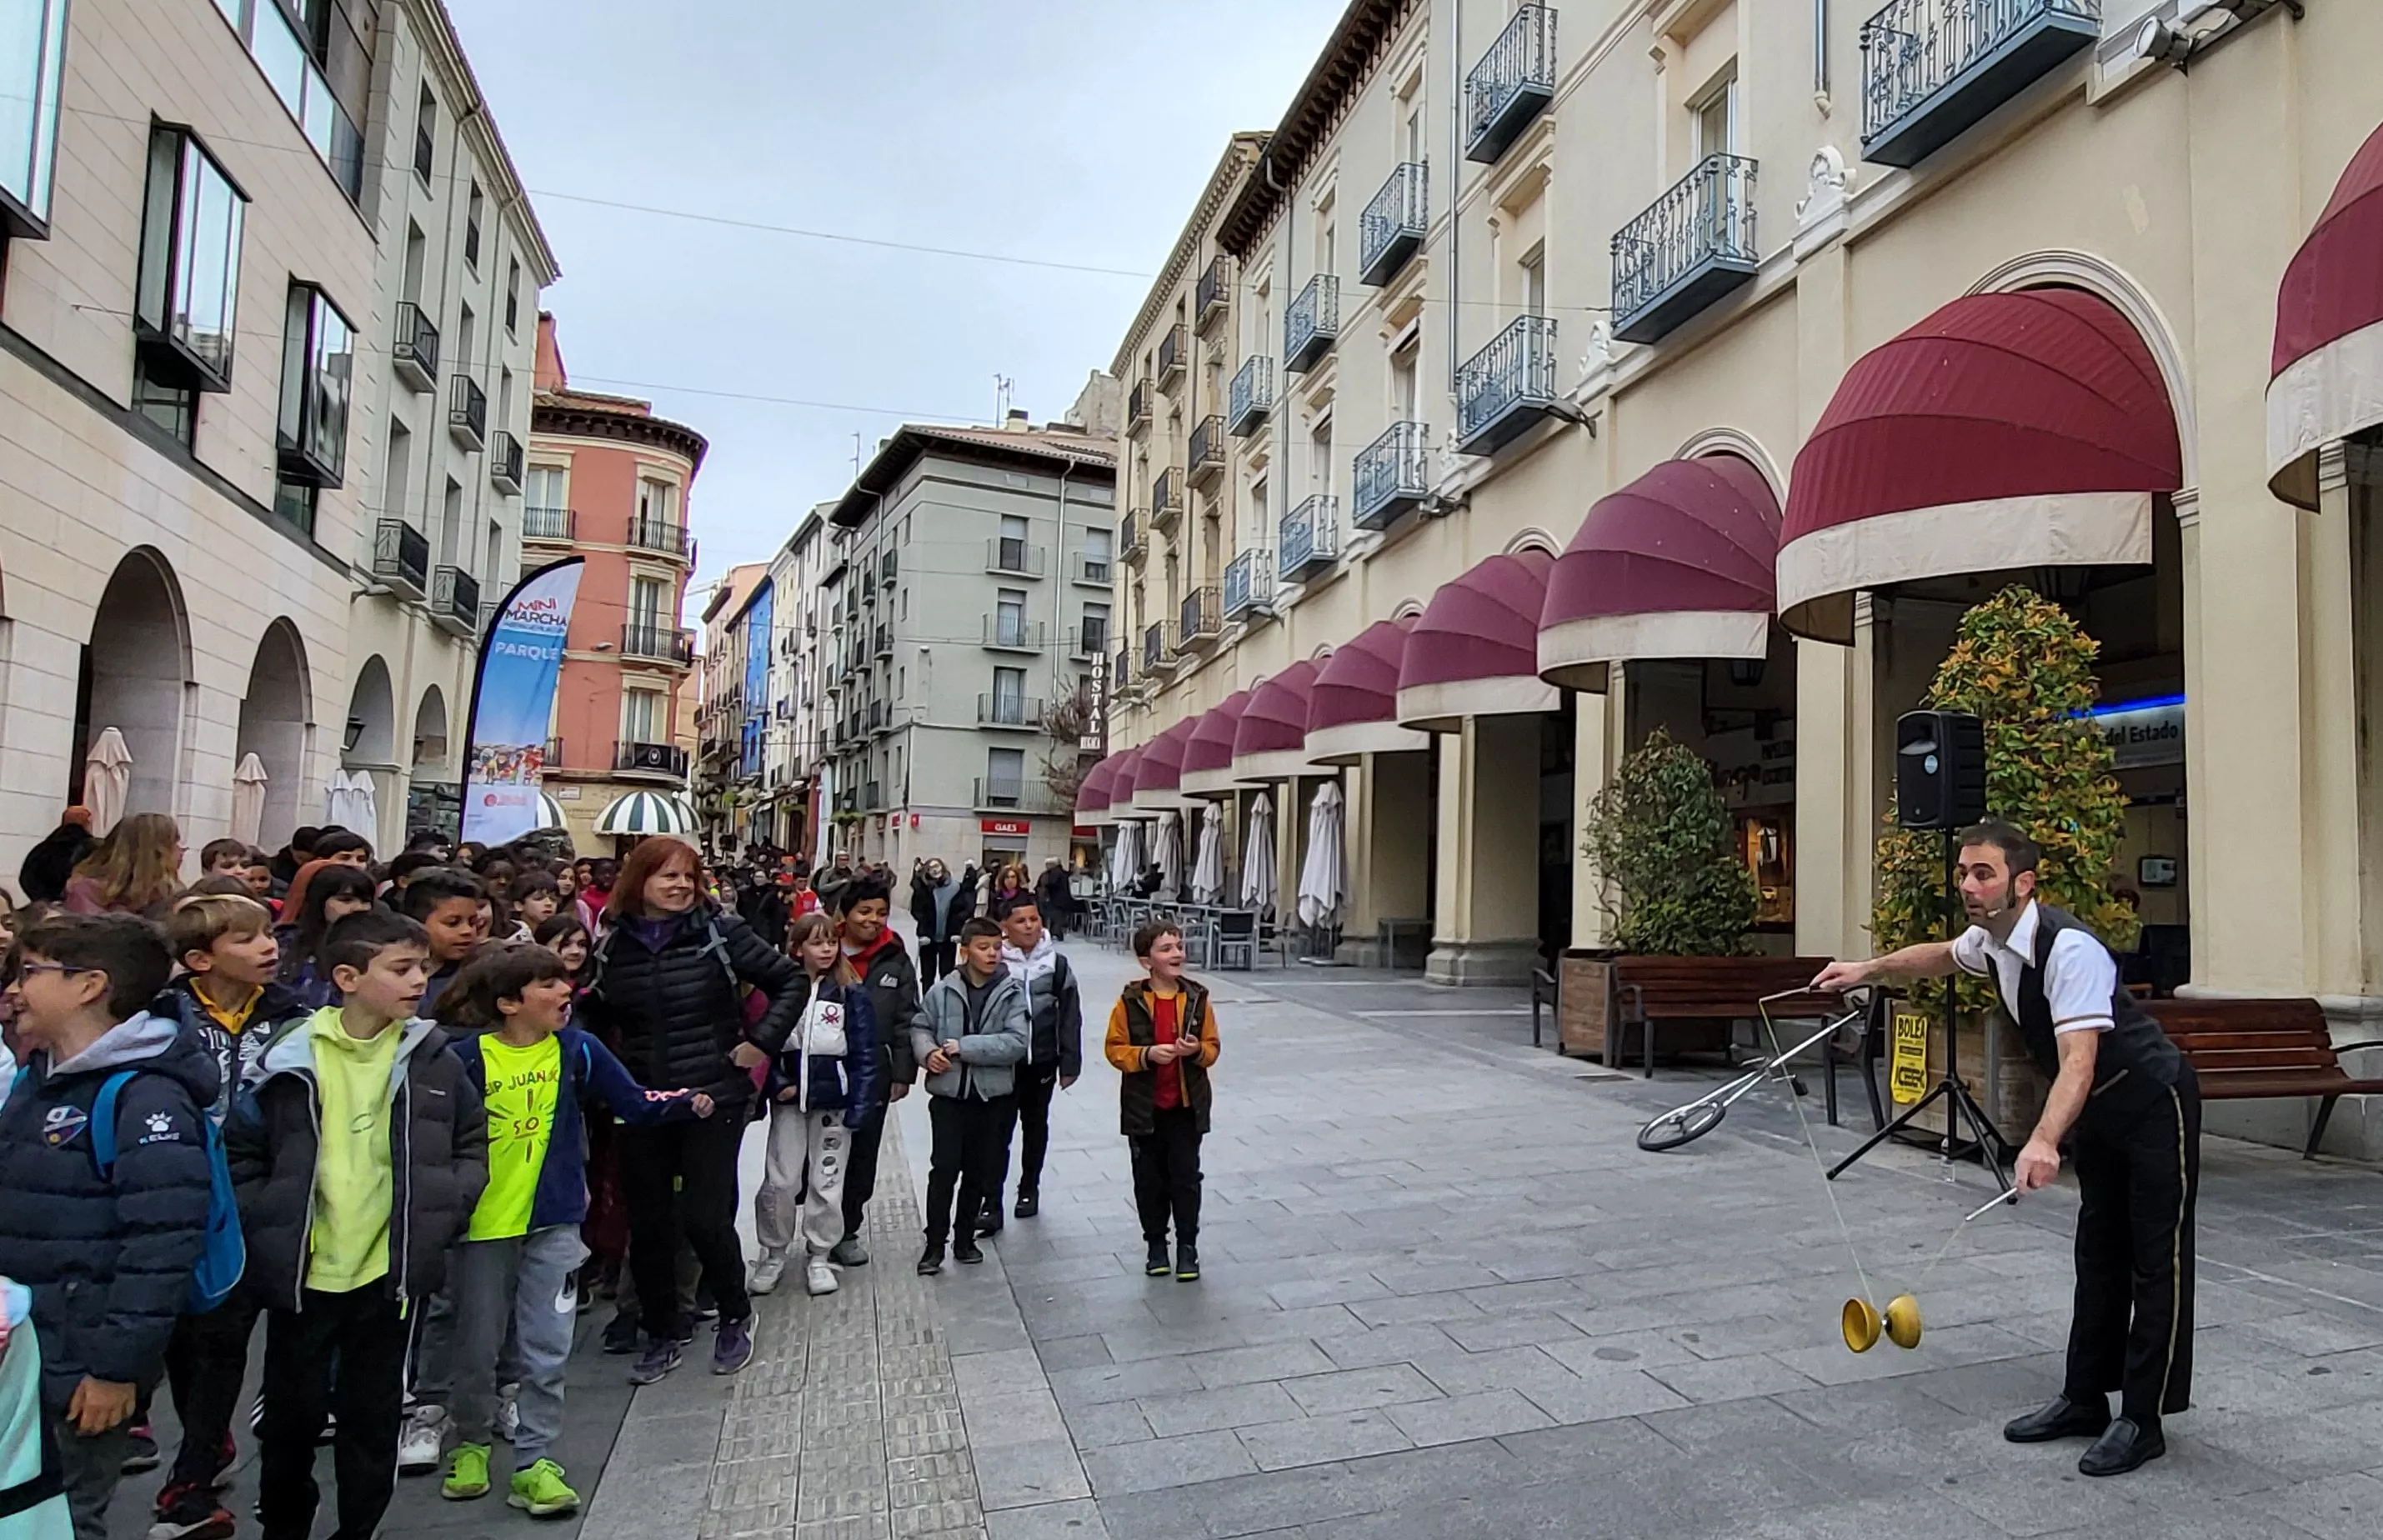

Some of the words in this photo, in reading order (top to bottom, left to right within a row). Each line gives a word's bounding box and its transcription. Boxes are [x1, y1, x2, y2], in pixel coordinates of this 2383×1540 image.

[518, 597, 557, 612] MINI
[505, 609, 567, 627] MARCHA
[1089, 652, 1104, 733] HOSTAL
[2130, 720, 2178, 742] Estado
[1898, 1018, 1925, 1038] BOLEA
[508, 1070, 545, 1090] JUAN
